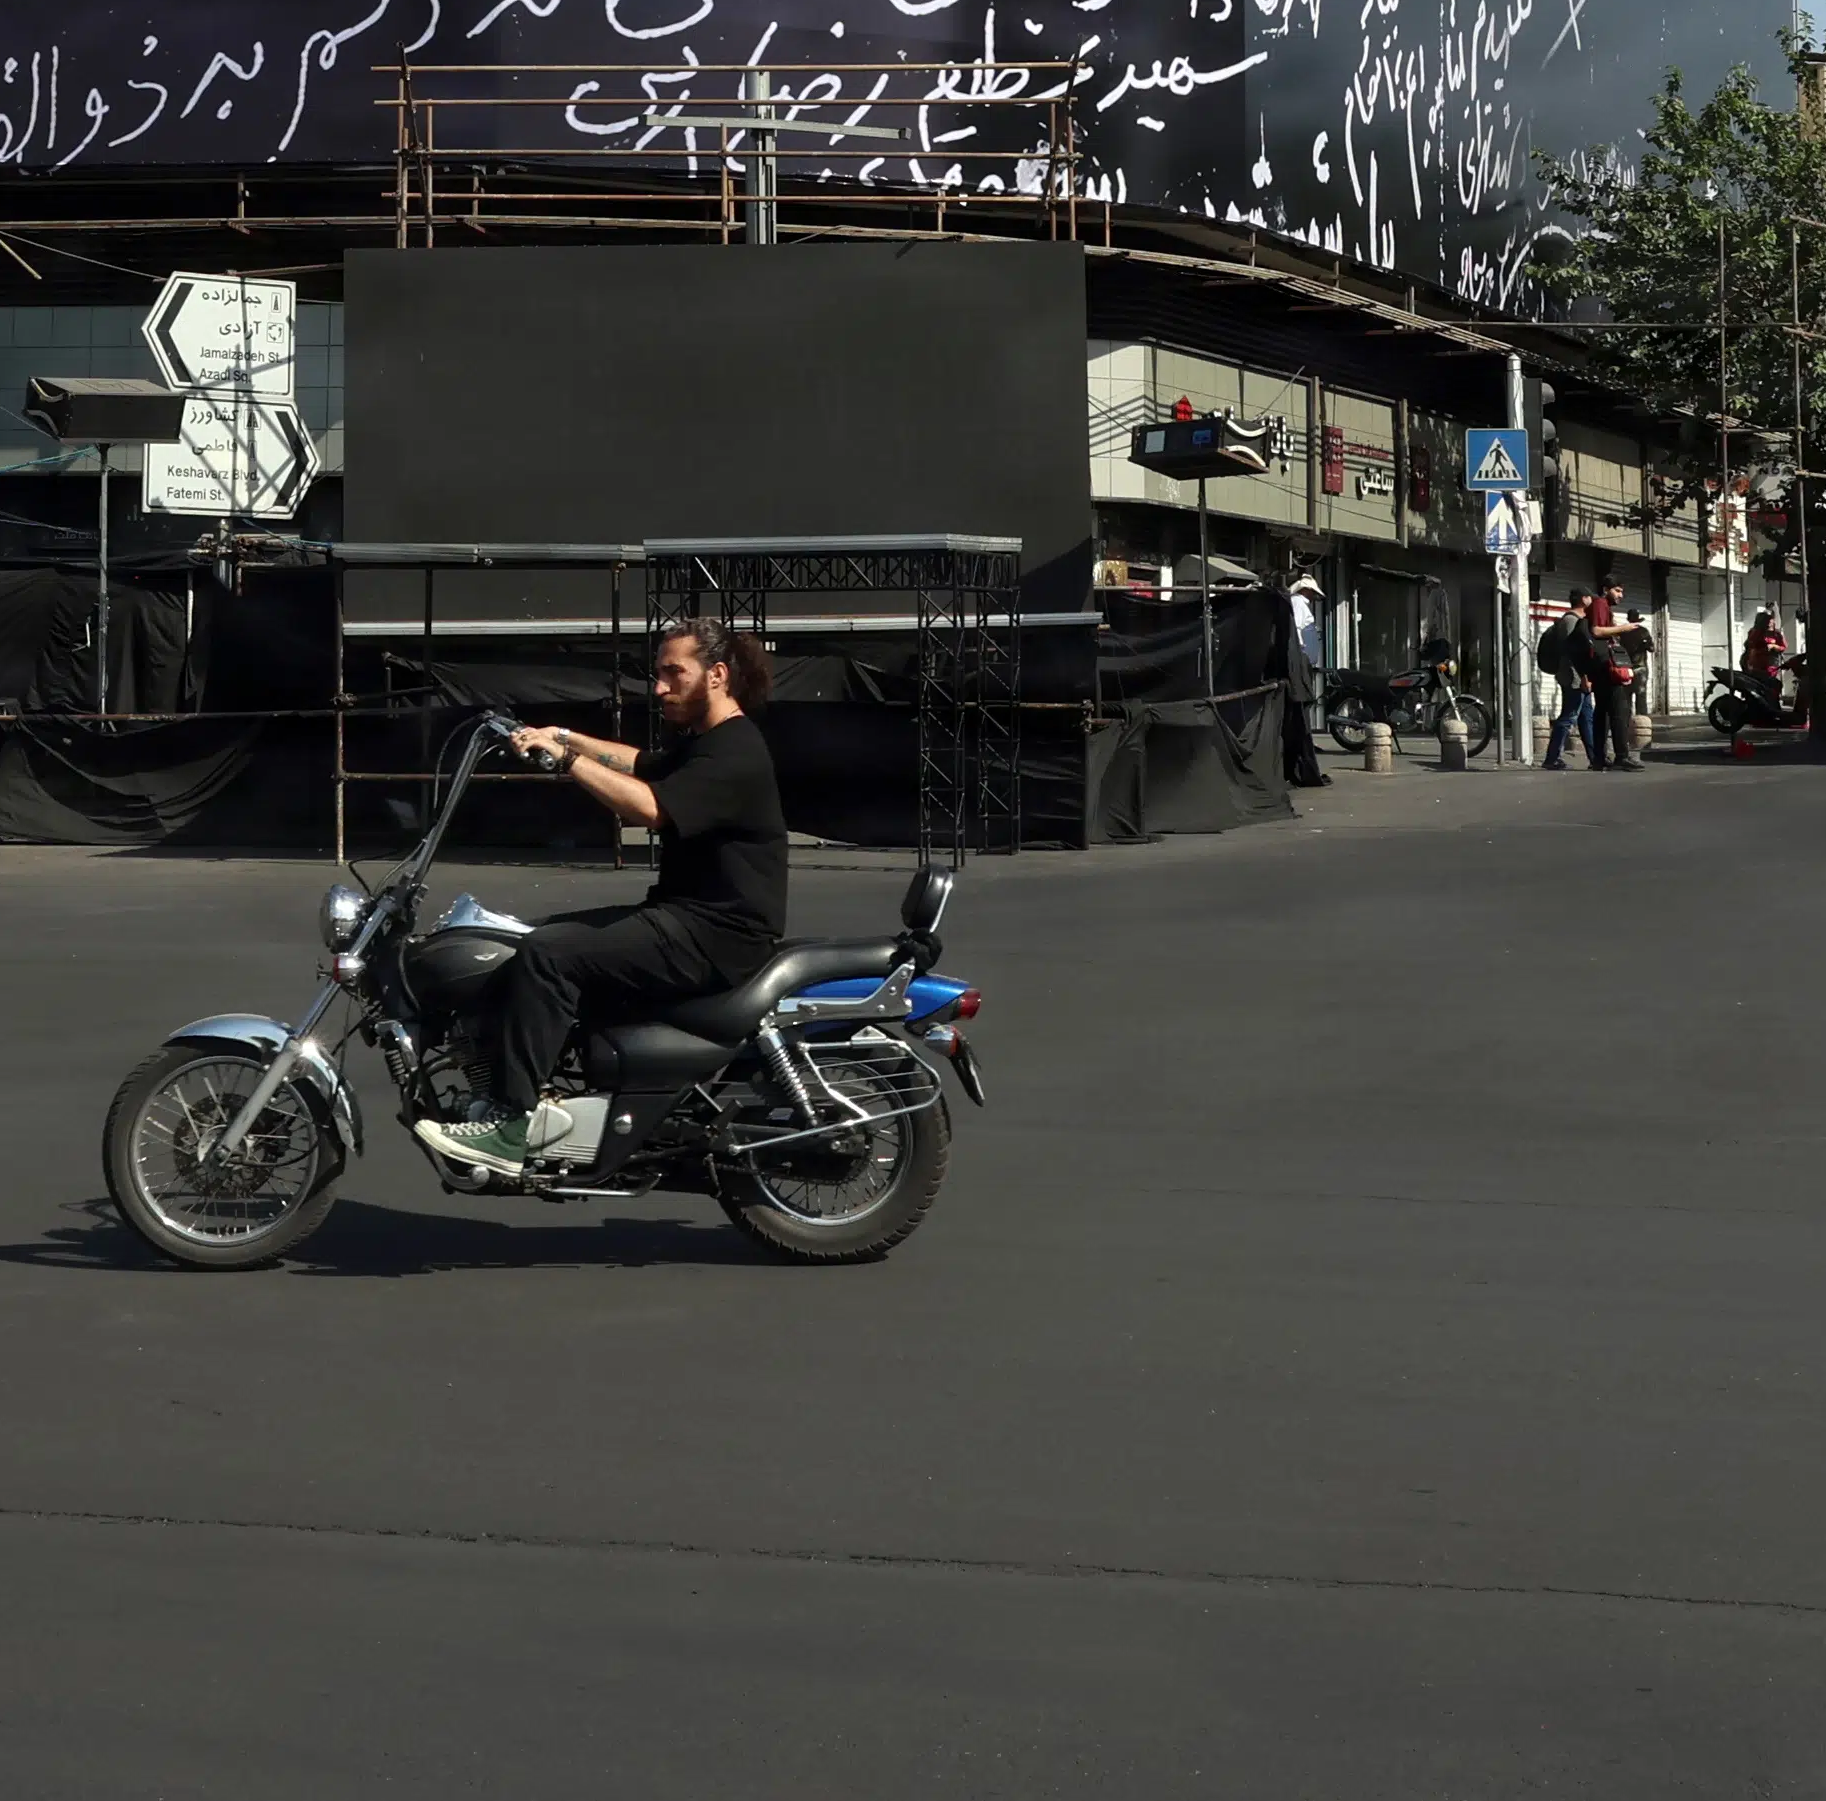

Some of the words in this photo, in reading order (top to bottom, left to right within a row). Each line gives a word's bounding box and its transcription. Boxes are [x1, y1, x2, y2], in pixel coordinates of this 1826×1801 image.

[202, 287, 262, 306] جمالزاده
[219, 320, 262, 340] آزادی
[199, 346, 265, 362] Jamalzadeh
[199, 368, 229, 381] Azadi
[233, 370, 252, 384] Sq.
[189, 406, 240, 425] کشاورز
[192, 438, 238, 456] فاطمی
[167, 465, 229, 480] Keshavarz
[233, 467, 261, 481] Blvd.
[166, 487, 207, 501] Fatemi
[209, 488, 225, 501] St.
